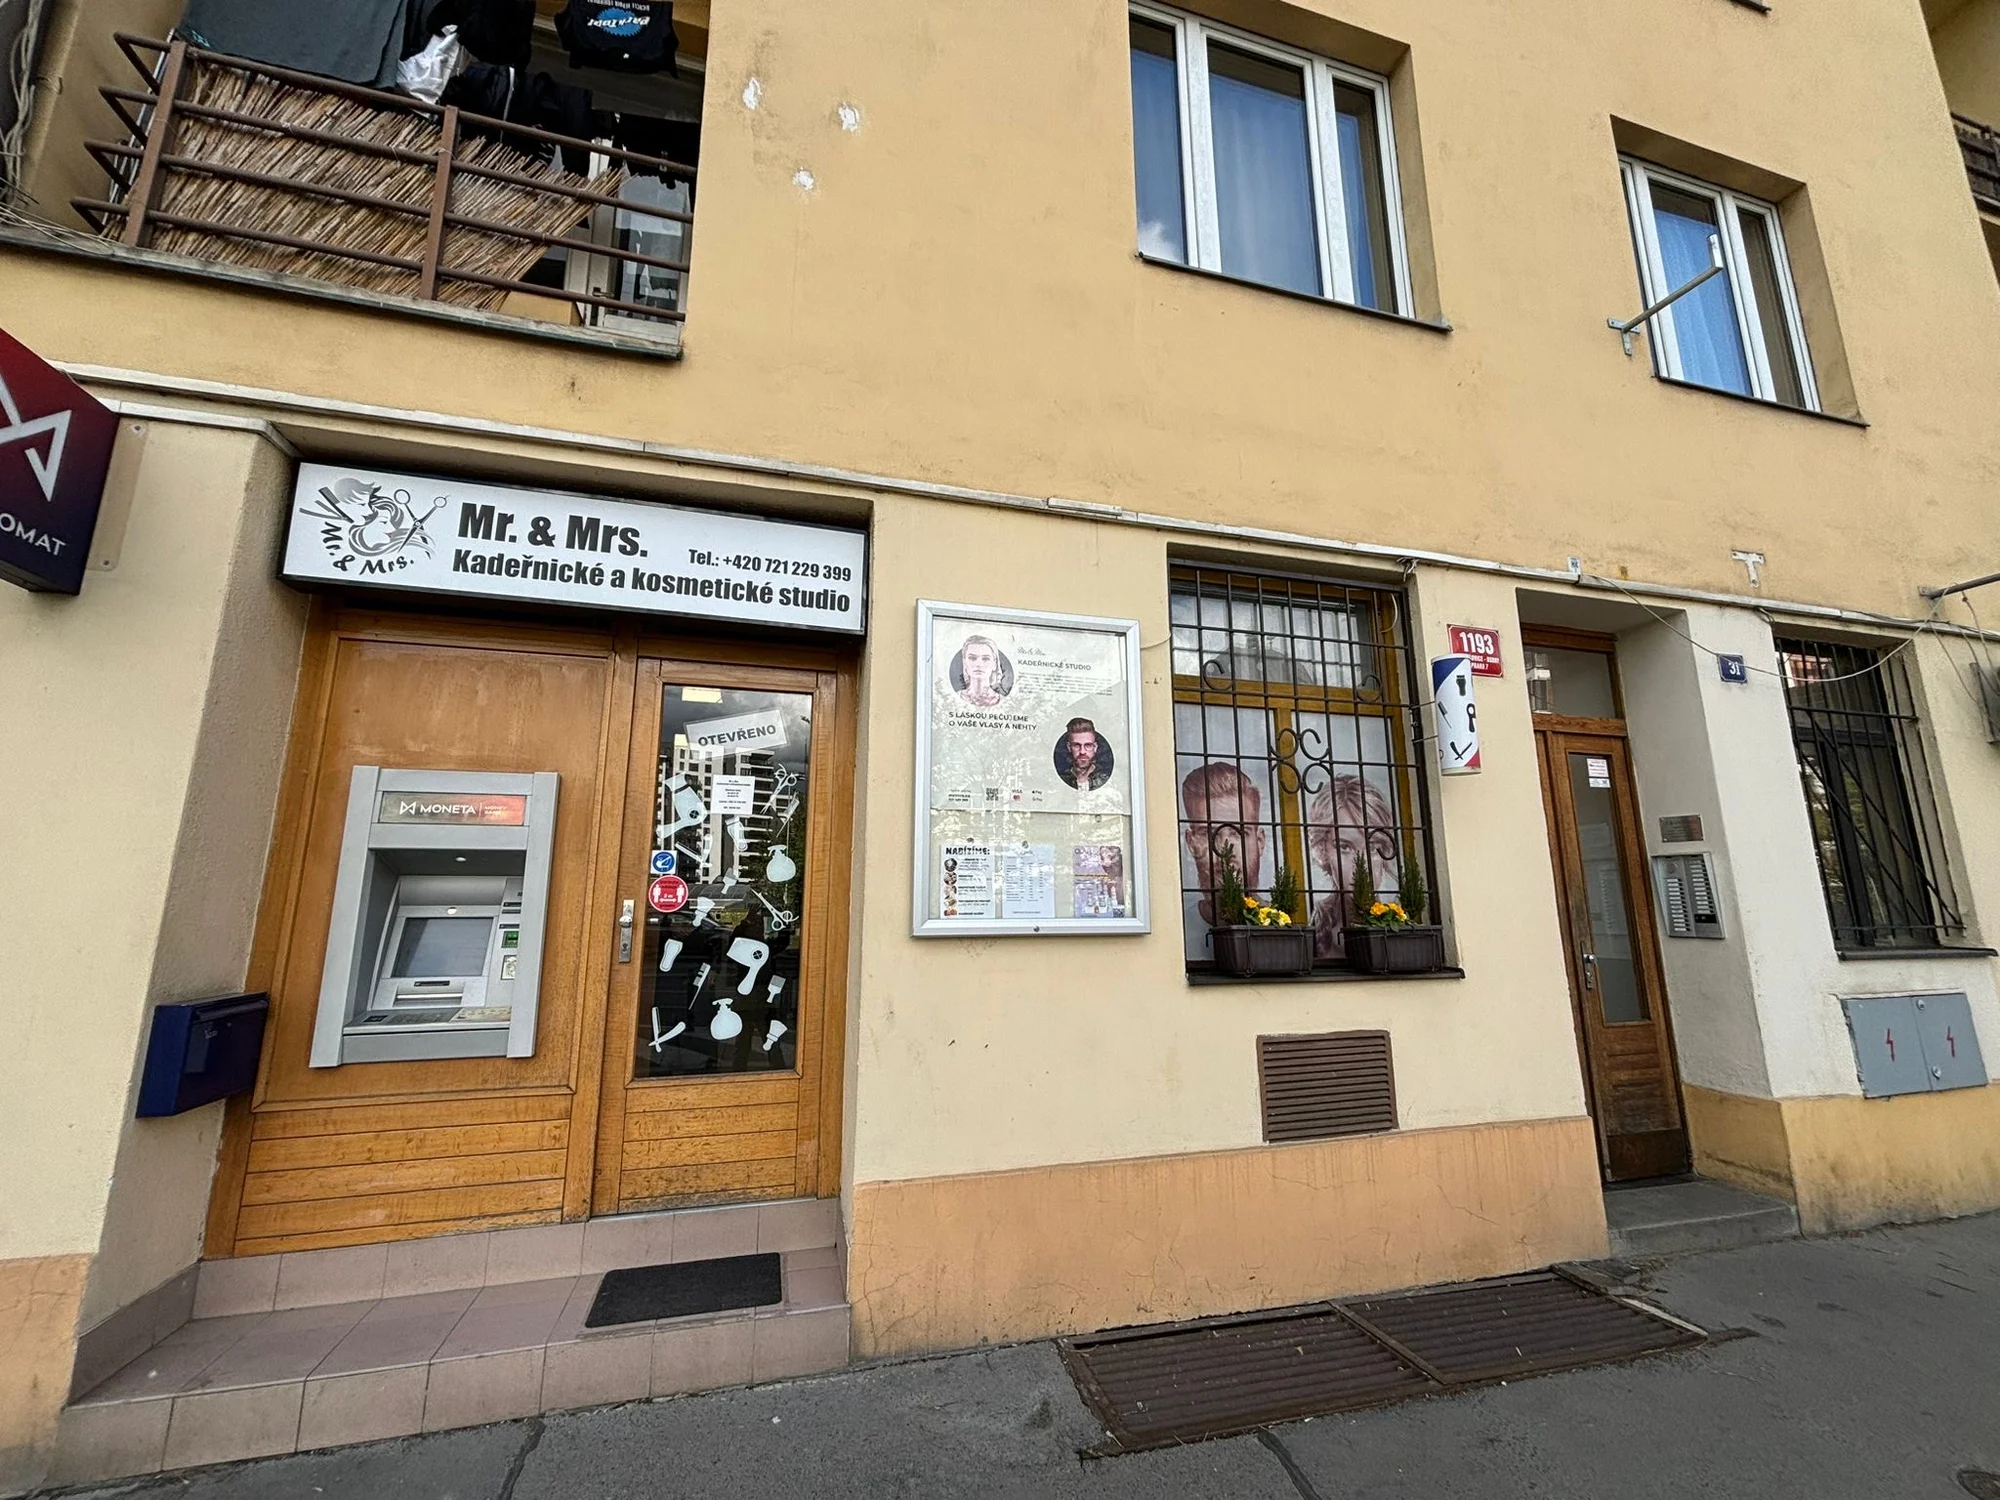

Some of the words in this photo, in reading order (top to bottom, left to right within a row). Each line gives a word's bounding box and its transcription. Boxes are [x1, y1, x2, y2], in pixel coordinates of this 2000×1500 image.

[0, 512, 67, 556] OMAT
[458, 502, 518, 543] Mr.
[527, 516, 556, 547] &
[565, 514, 648, 557] Mrs.
[320, 521, 344, 556] Mr.
[332, 554, 356, 572] &
[359, 555, 414, 575] Mrs.
[688, 549, 719, 567] Tel.:
[722, 554, 762, 572] +420
[765, 557, 788, 575] 721
[792, 561, 820, 578] 229
[823, 565, 852, 582] 399
[452, 548, 605, 586] Kadeřnické
[610, 568, 626, 589] a
[631, 567, 773, 604] kosmetické
[779, 586, 850, 612] studio
[1459, 631, 1494, 655] 1193
[1065, 662, 1092, 671] STUDIO
[1728, 660, 1740, 676] 31
[698, 723, 777, 747] OTEVŘENO
[956, 719, 978, 728] VAŠE
[979, 722, 1003, 730] VLASY
[1012, 723, 1037, 732] NEHTY
[420, 803, 476, 814] MONETA
